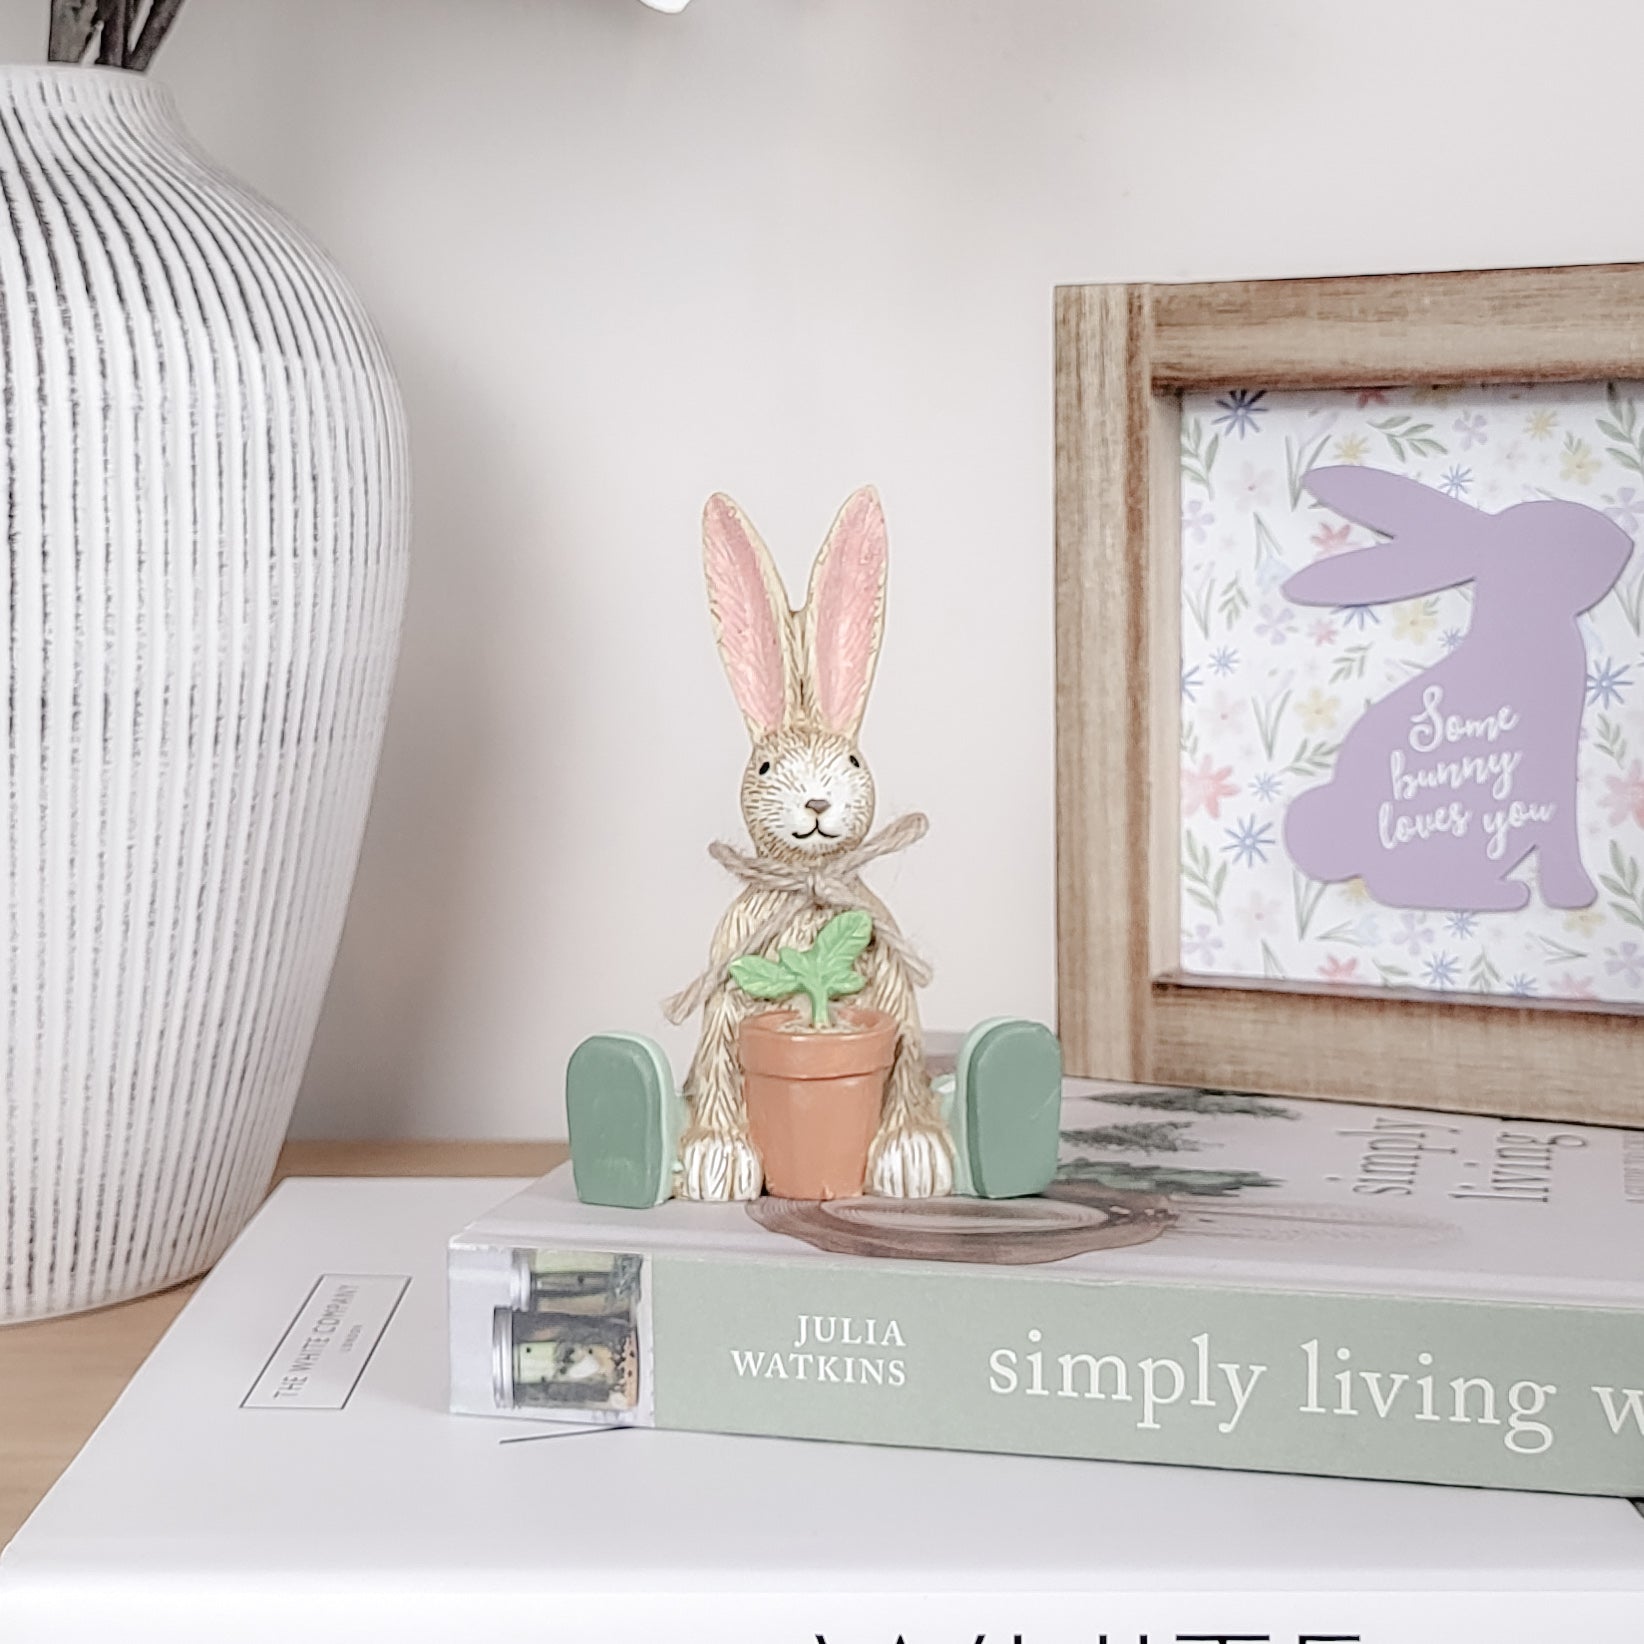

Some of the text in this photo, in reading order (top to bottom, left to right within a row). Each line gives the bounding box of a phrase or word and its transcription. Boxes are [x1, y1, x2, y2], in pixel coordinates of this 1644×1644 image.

[1408, 685, 1520, 752] Some
[1390, 750, 1522, 800] bunny
[1378, 800, 1557, 860] loves you
[1325, 1116, 1460, 1195] simply
[1448, 1131, 1588, 1203] living
[273, 1284, 360, 1399] THE WHITE COMPANY
[794, 1314, 906, 1348] JULIA
[730, 1350, 906, 1386] WATKINS
[988, 1328, 1268, 1433] simply
[1299, 1338, 1557, 1454] living
